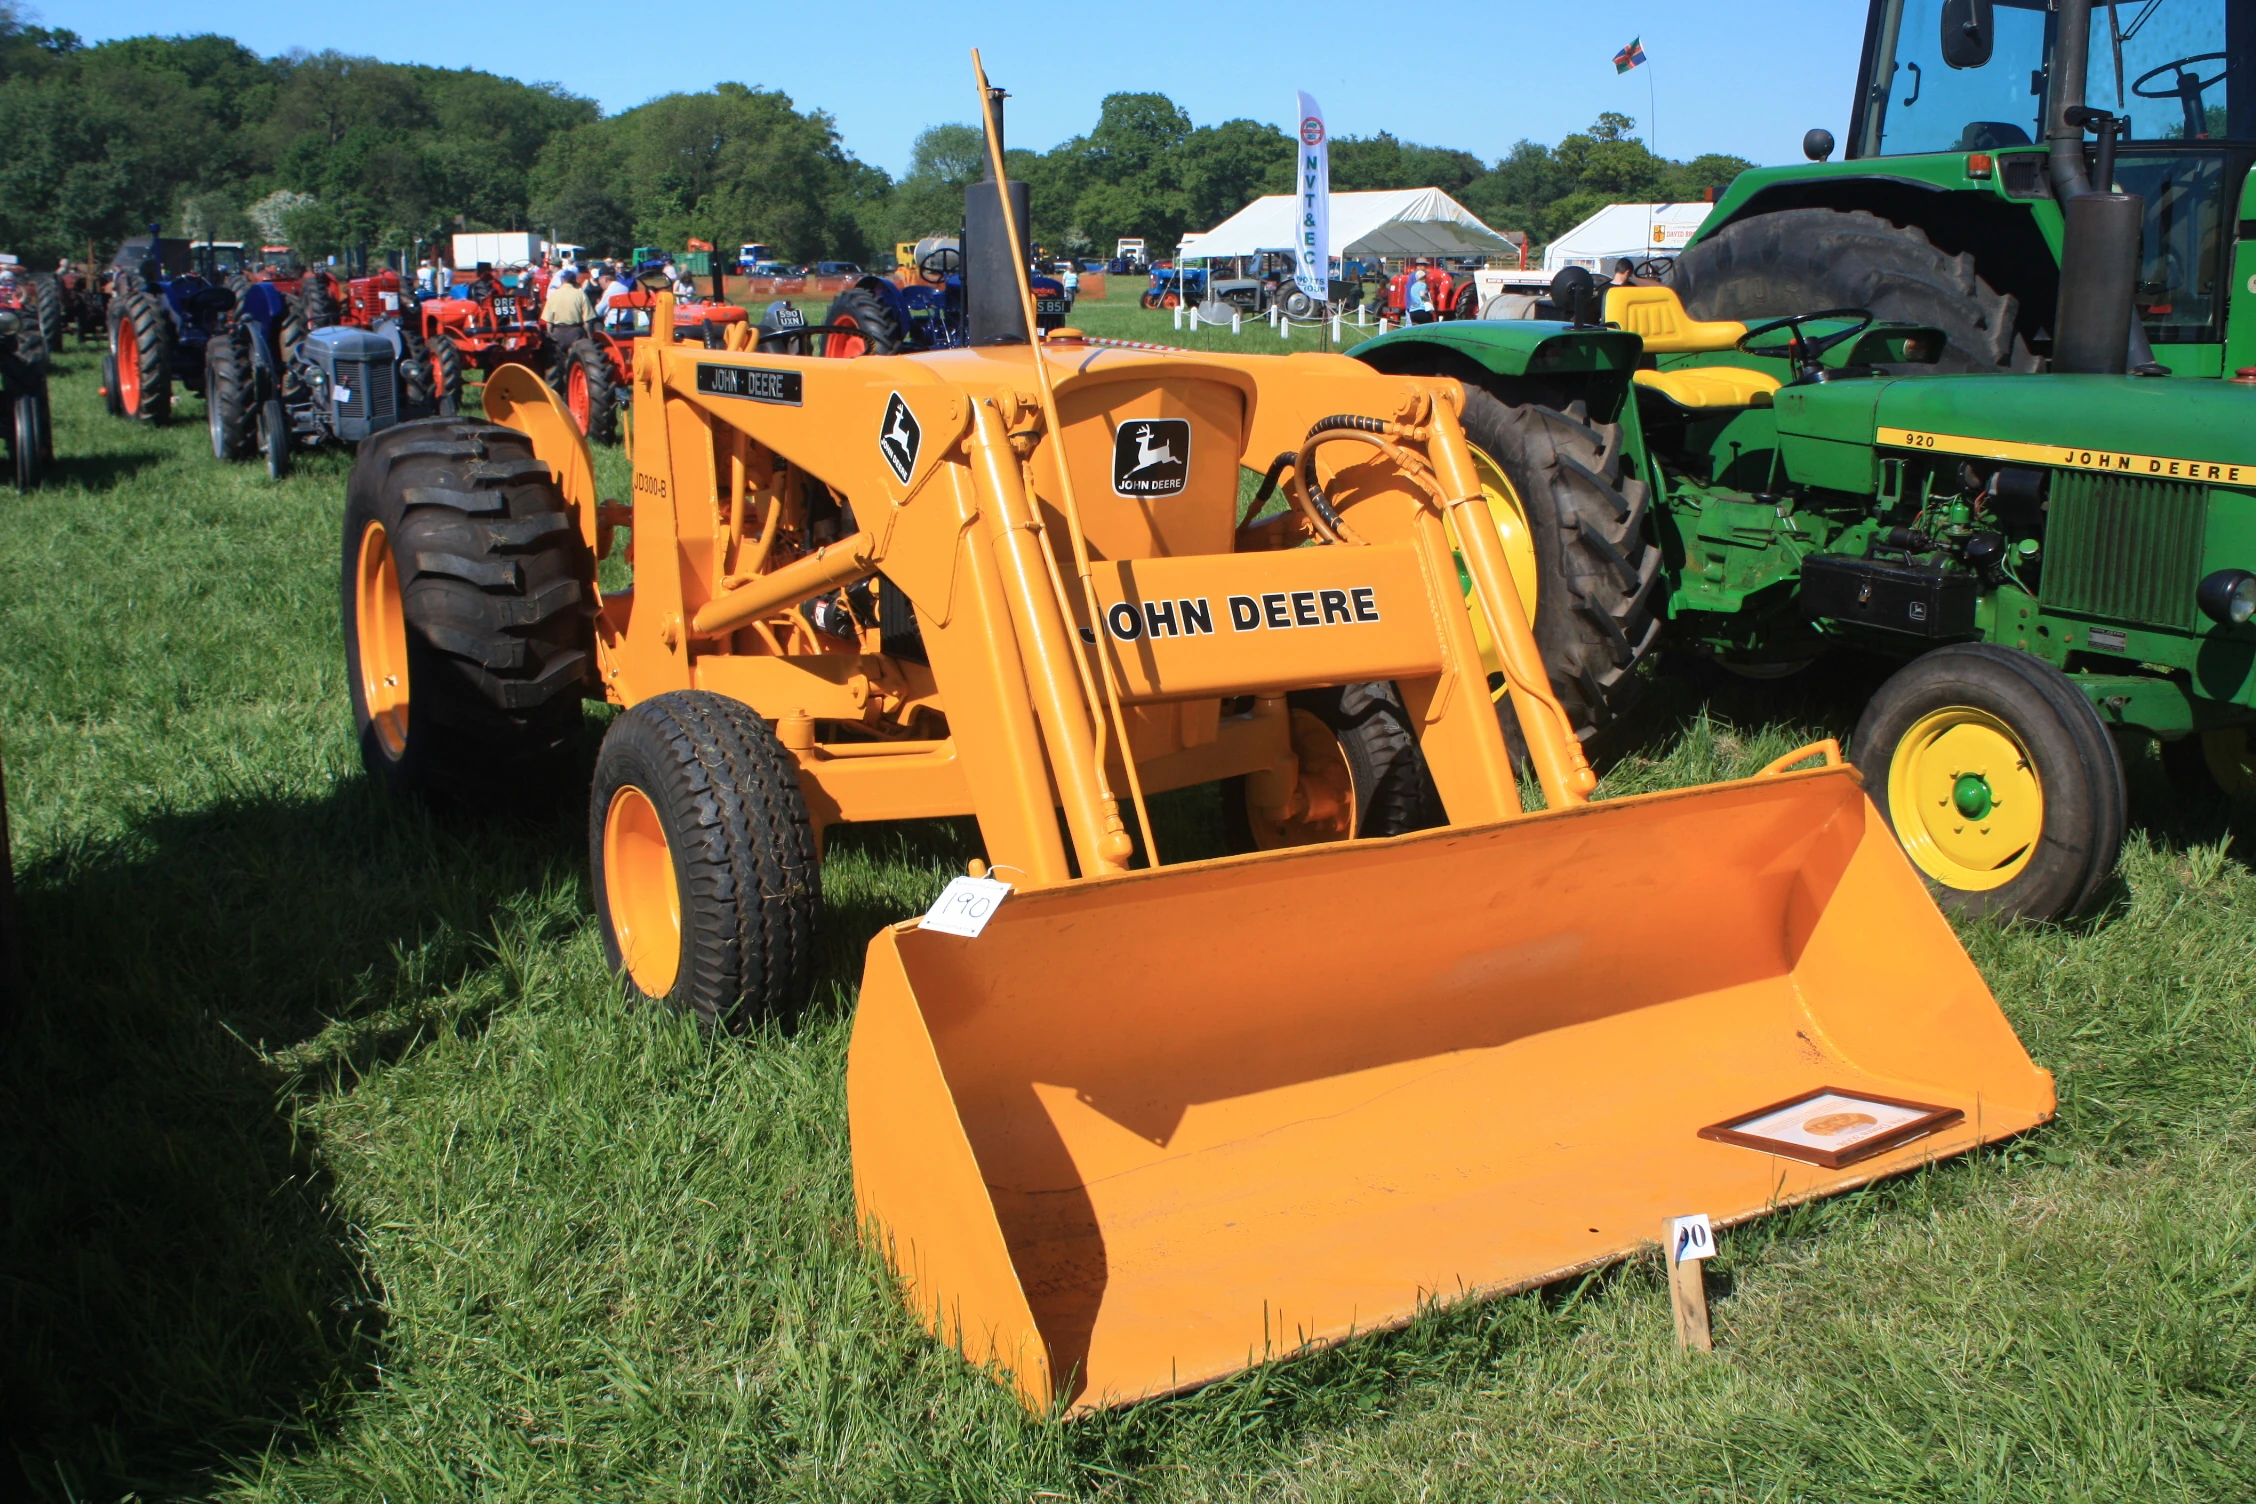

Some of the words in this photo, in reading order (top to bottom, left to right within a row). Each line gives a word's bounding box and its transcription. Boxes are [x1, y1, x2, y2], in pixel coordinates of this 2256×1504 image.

[1303, 156, 1319, 265] NVT&EC
[494, 306, 516, 316] 853
[779, 310, 798, 318] 590
[1046, 301, 1065, 312] 851
[780, 317, 800, 326] UXN
[711, 368, 738, 393] JOHN
[748, 371, 784, 398] DEERE
[1906, 433, 1935, 448] 920
[880, 437, 894, 459] JOHN
[892, 454, 908, 481] DEERE
[2064, 450, 2131, 470] JOHN
[2149, 459, 2240, 482] DEERE
[633, 471, 667, 498] JD300-B
[1118, 480, 1149, 490] JOHN
[1151, 478, 1182, 490] DEERE
[1226, 586, 1380, 633] DEERE
[942, 892, 991, 918] 190
